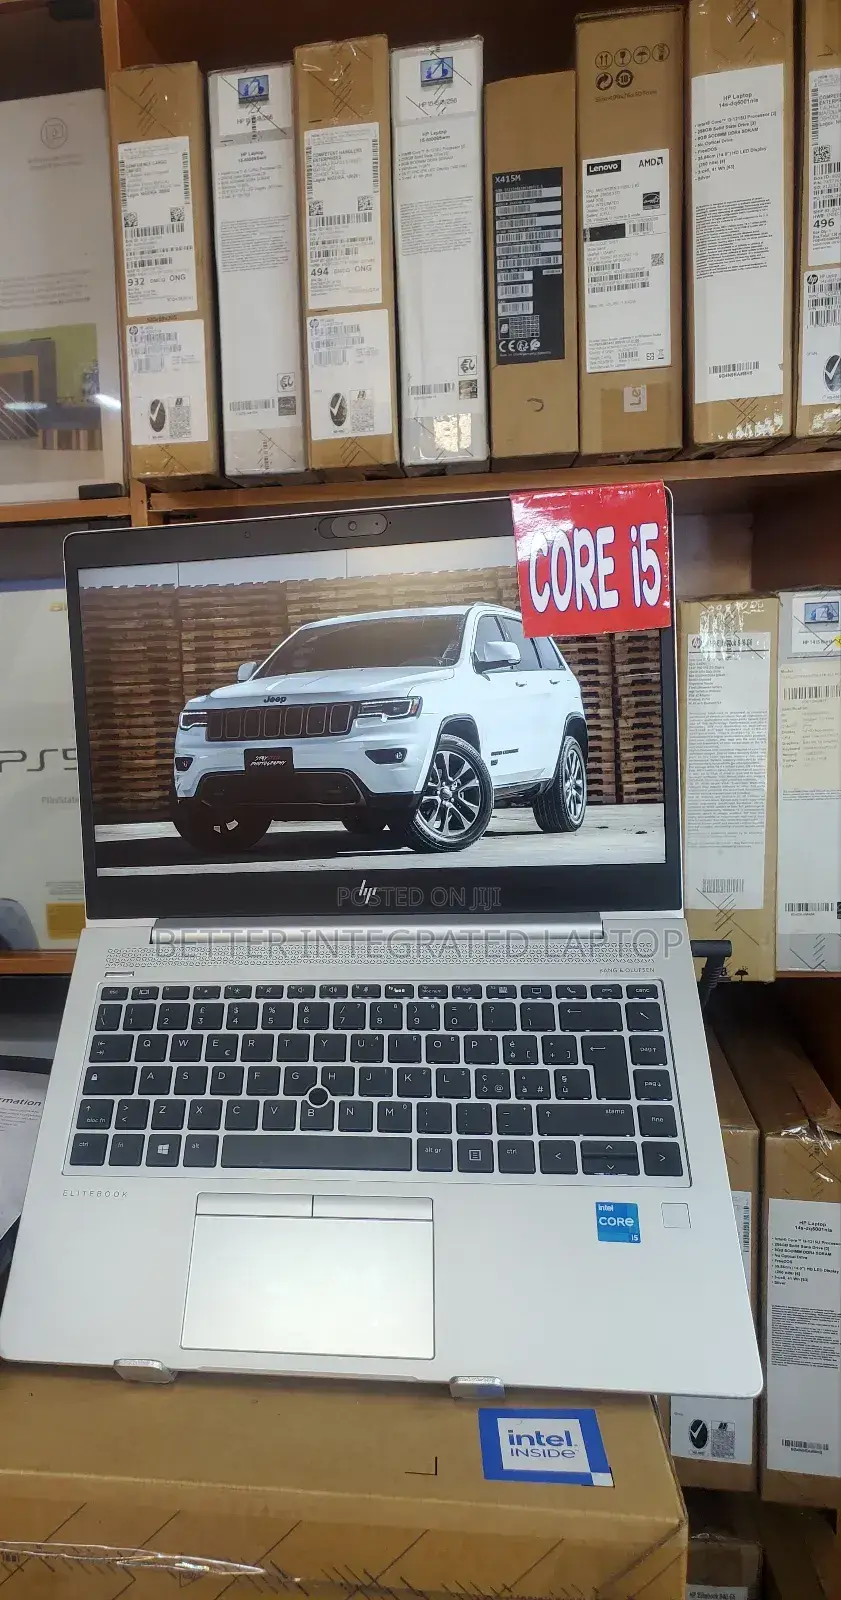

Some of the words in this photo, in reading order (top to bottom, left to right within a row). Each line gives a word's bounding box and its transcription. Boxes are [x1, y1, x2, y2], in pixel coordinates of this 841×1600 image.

[639, 158, 657, 168] AMD
[589, 163, 618, 172] Lenovo
[495, 174, 521, 184] X415M
[813, 218, 835, 229] 496
[311, 267, 329, 277] 494
[128, 277, 145, 286] 932
[170, 274, 186, 282] ONG
[529, 525, 620, 613] CORE
[630, 522, 662, 609] i5
[248, 1039, 255, 1047] R
[146, 1072, 155, 1080] A
[182, 1072, 188, 1080] S
[218, 1072, 226, 1080] D
[254, 1072, 261, 1080] F
[292, 1072, 300, 1080] G
[328, 1072, 336, 1080] H
[366, 1073, 372, 1081] J
[404, 1074, 412, 1082] K
[443, 1074, 450, 1083] L
[159, 1106, 166, 1114] Z
[195, 1106, 203, 1114] X
[232, 1106, 240, 1114] C
[270, 1106, 278, 1114] V
[308, 1109, 315, 1117] B
[346, 1108, 354, 1116] N
[386, 1108, 394, 1116] M
[62, 1190, 128, 1198] ELITEBOOK
[598, 1204, 614, 1212] intel
[507, 1429, 572, 1447] intel
[510, 1448, 576, 1459] INSIDE
